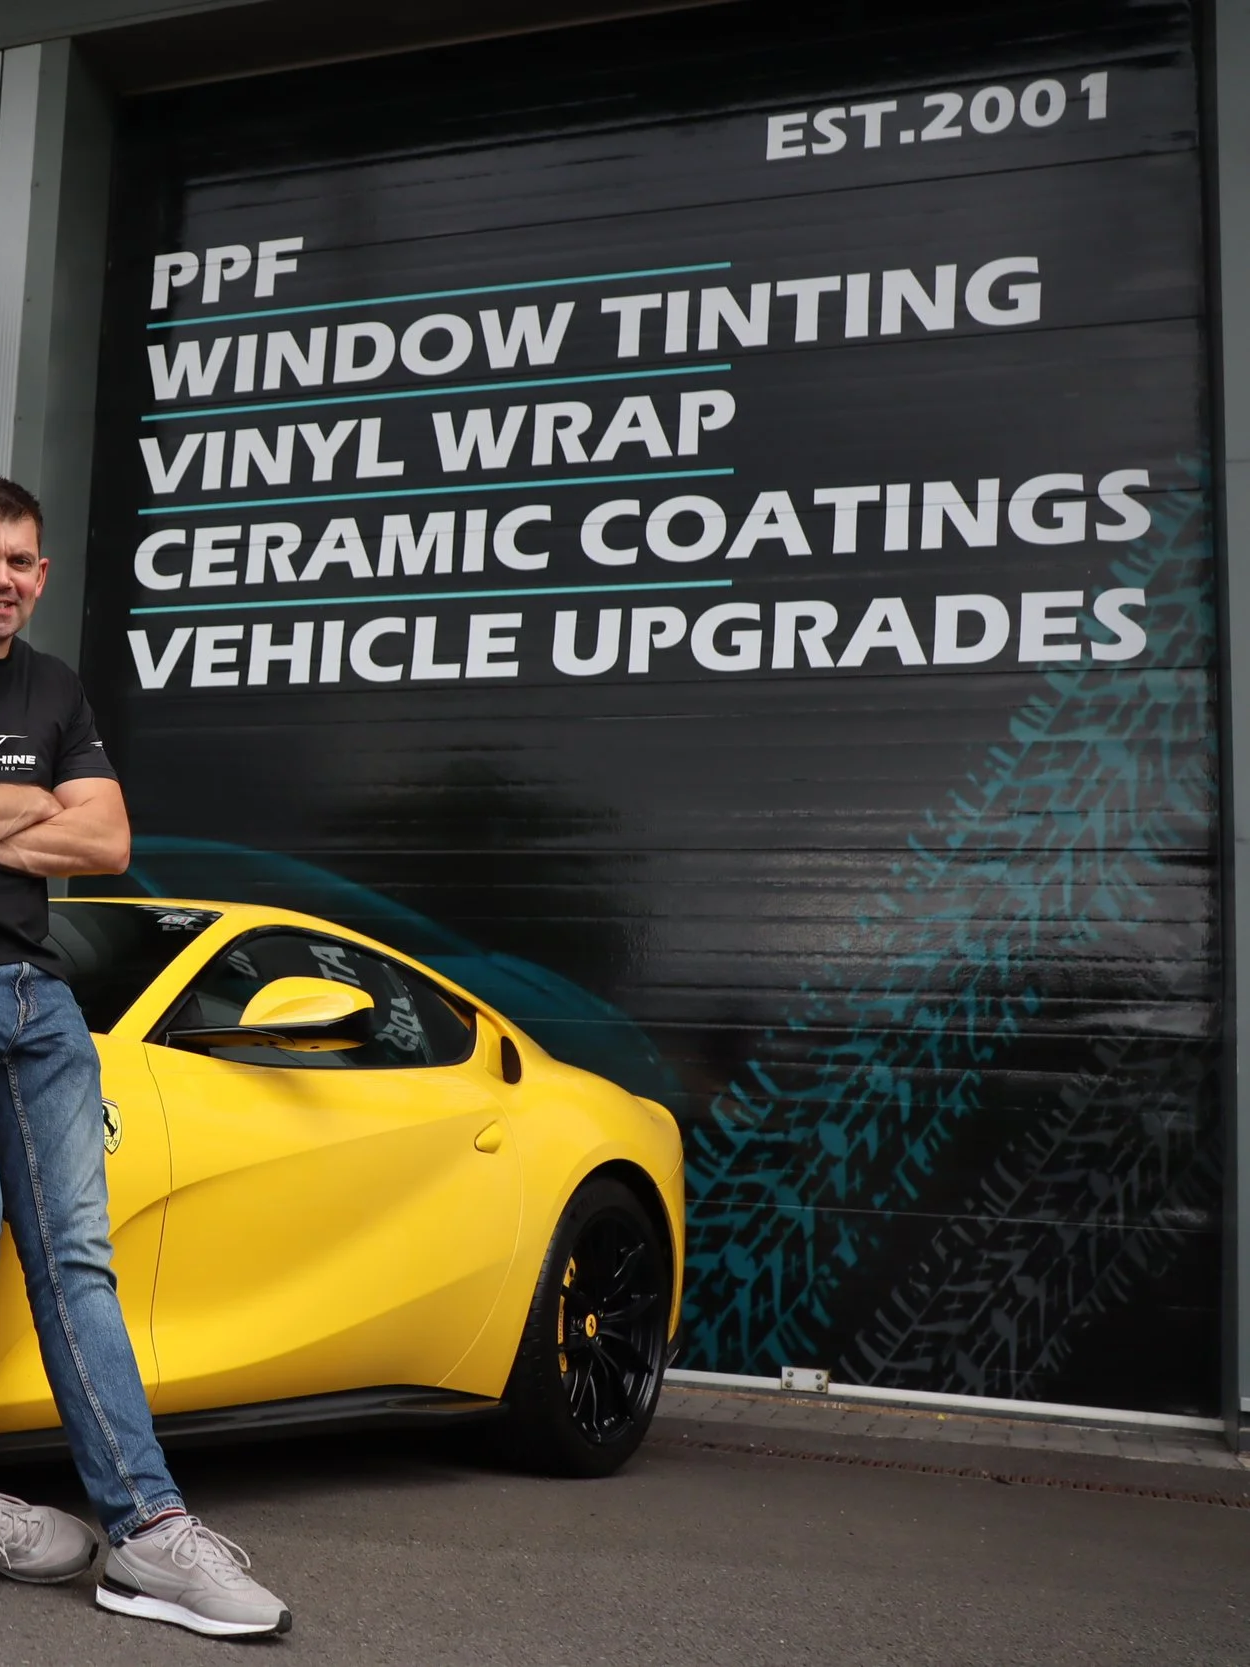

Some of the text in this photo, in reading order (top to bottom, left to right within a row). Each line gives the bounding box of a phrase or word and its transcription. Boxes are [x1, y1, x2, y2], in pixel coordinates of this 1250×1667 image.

[766, 71, 1108, 160] EST.2001
[150, 236, 303, 309] PPF
[147, 256, 1042, 400] WINDOW TINTING
[139, 389, 736, 494] VINYL WRAP
[134, 469, 1151, 590] CERAMIC COATINGS
[127, 588, 1147, 689] VEHICLE UPGRADES
